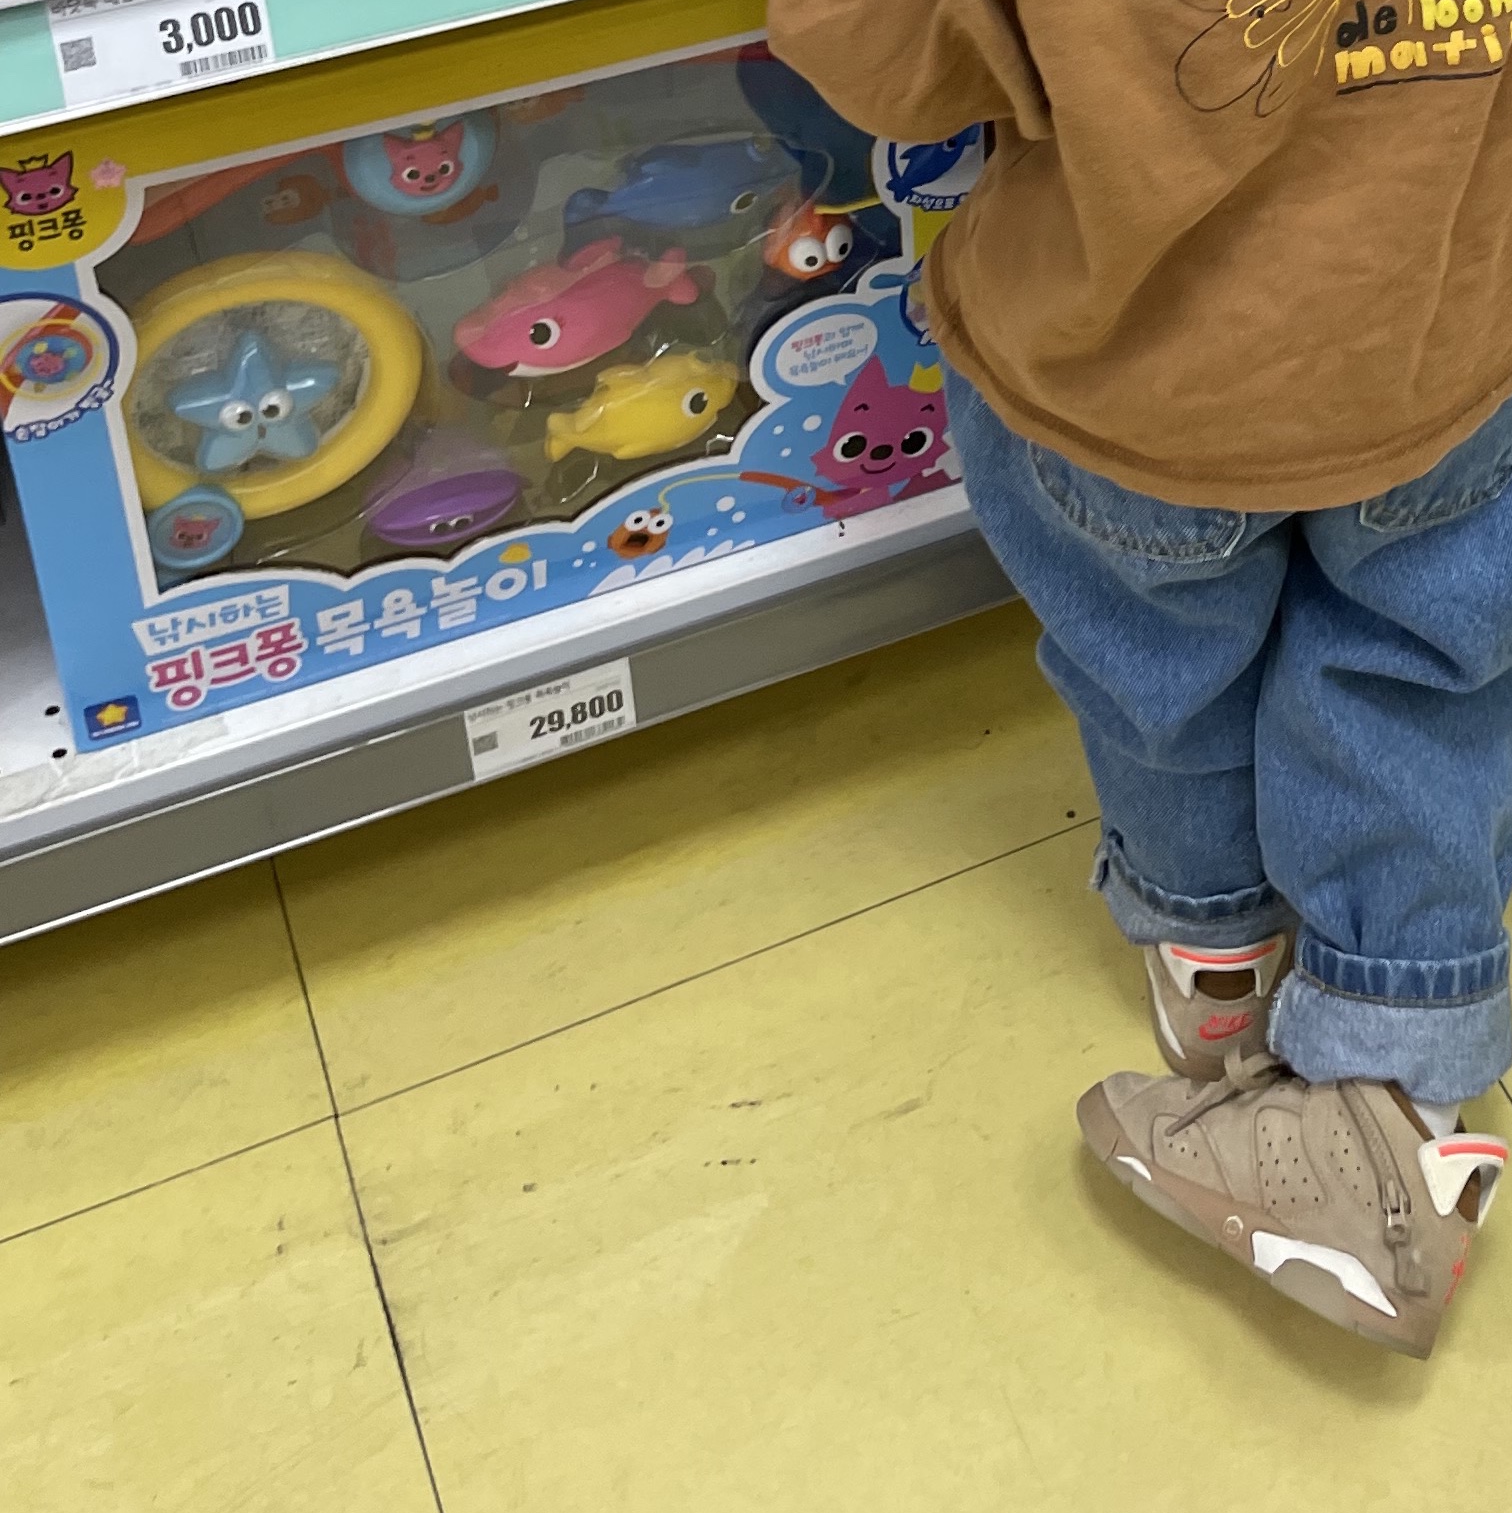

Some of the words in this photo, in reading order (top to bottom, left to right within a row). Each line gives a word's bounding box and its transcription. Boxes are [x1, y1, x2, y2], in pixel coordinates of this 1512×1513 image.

[158, 1, 263, 55] 3,000
[1336, 0, 1398, 49] de
[7, 208, 88, 252] 핑크퐁
[147, 589, 285, 644] 낚시하는
[150, 619, 305, 709] 핑크퐁
[315, 559, 548, 656] 목욕놀이
[529, 688, 625, 741] 29,800
